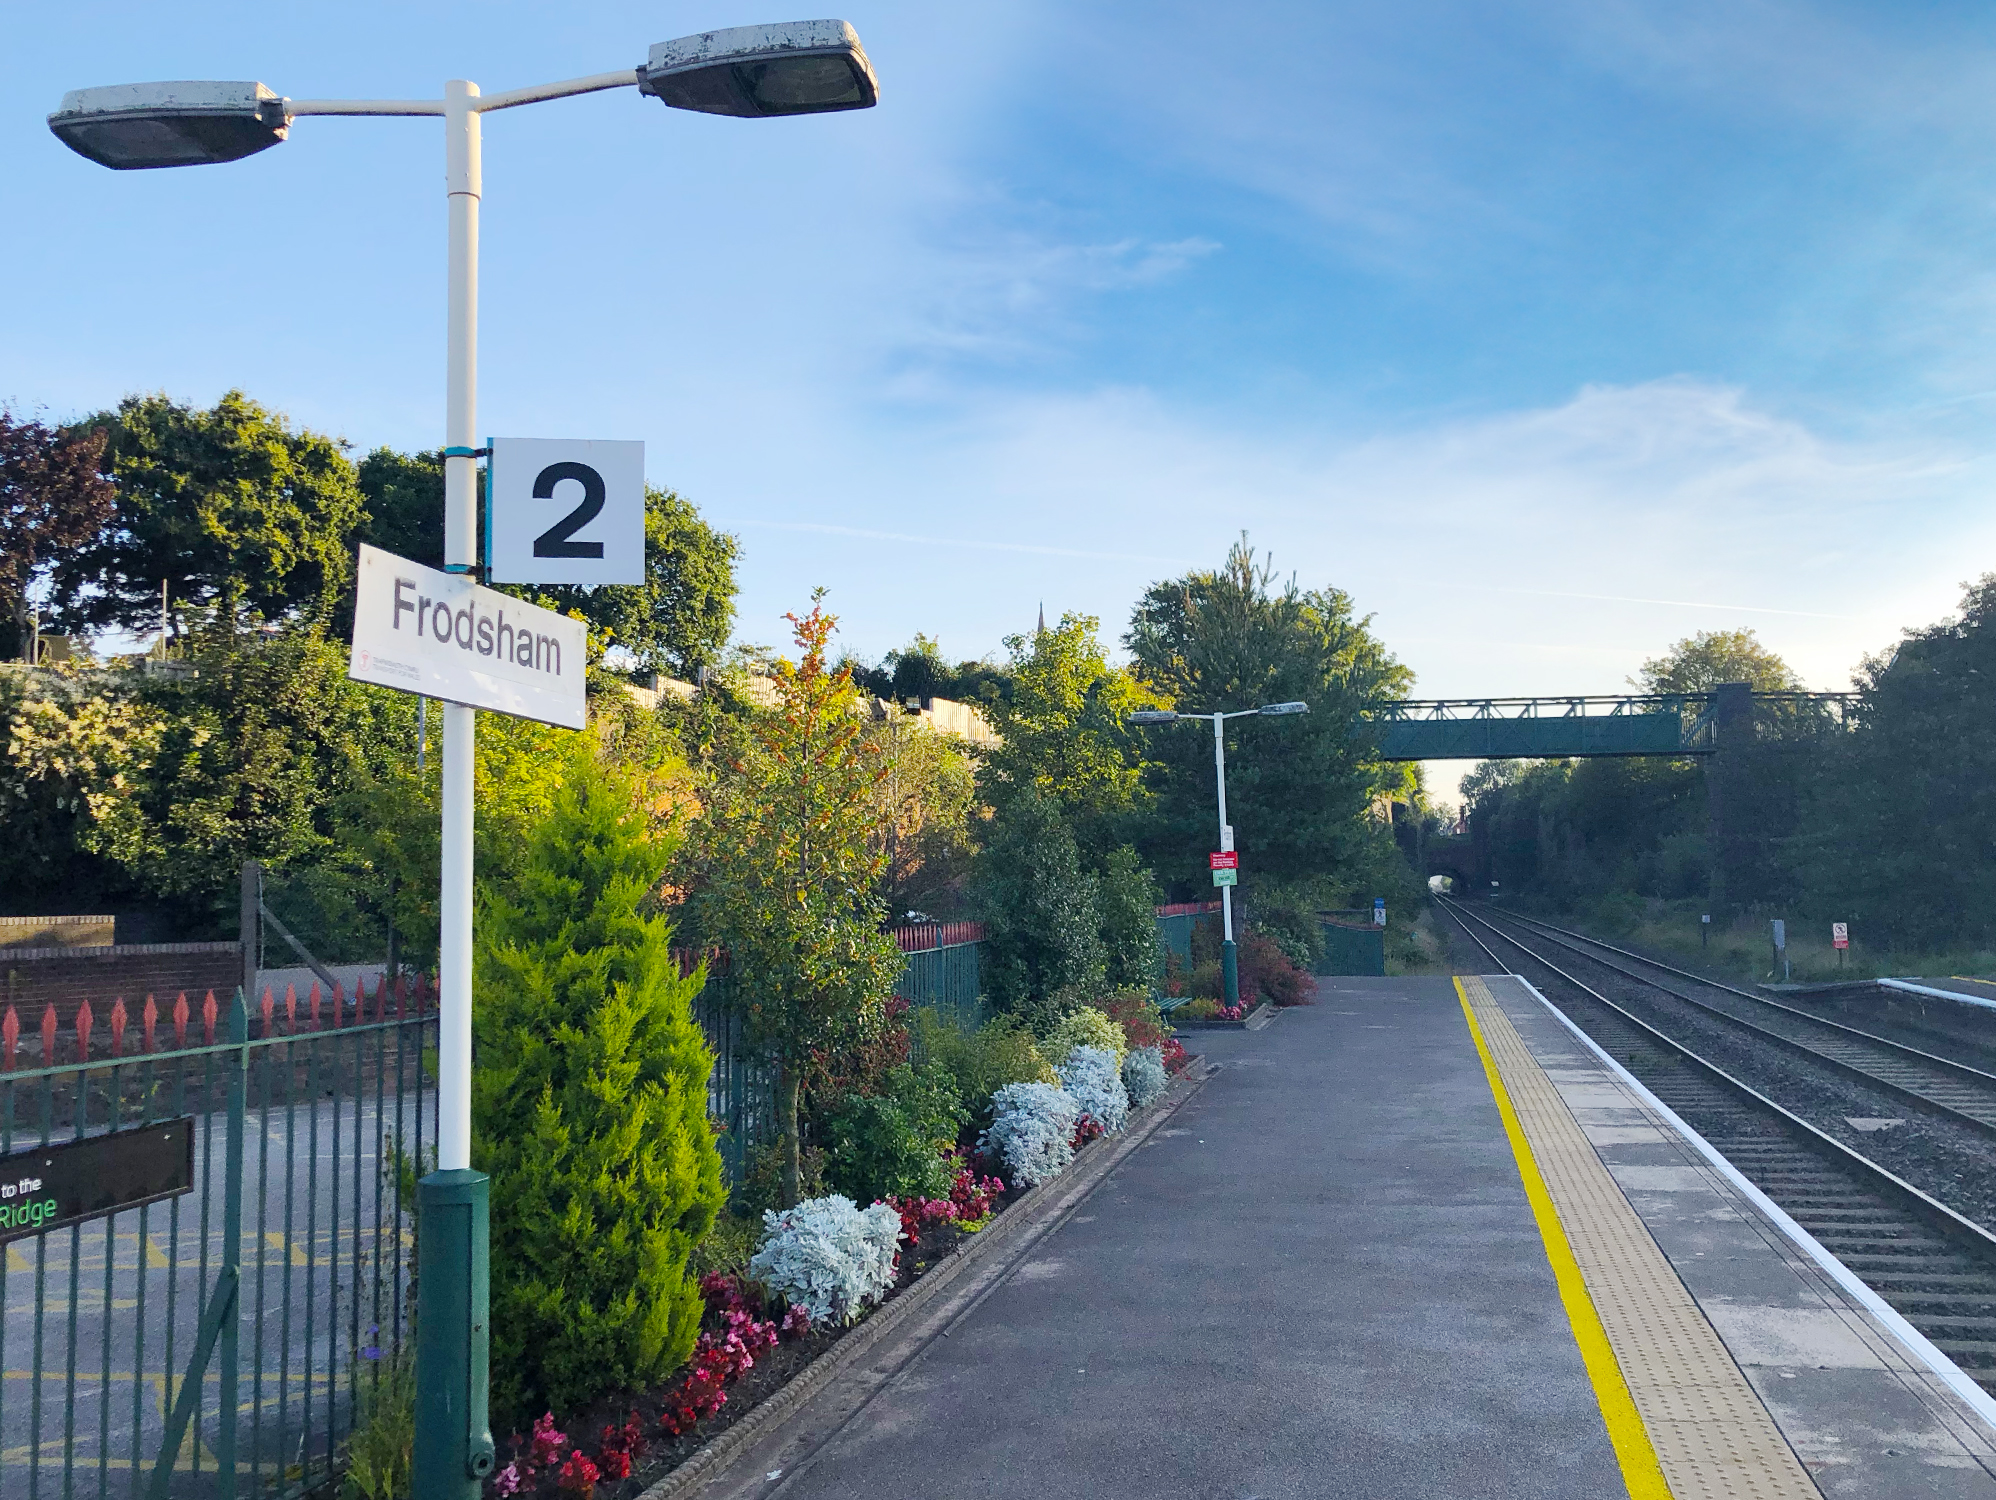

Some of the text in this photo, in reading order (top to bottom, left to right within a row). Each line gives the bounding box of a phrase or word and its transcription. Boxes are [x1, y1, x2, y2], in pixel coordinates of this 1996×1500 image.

[532, 461, 606, 559] 2
[393, 575, 561, 676] Frodsham
[0, 1198, 57, 1228] Ridge
[1, 1178, 42, 1198] to the
